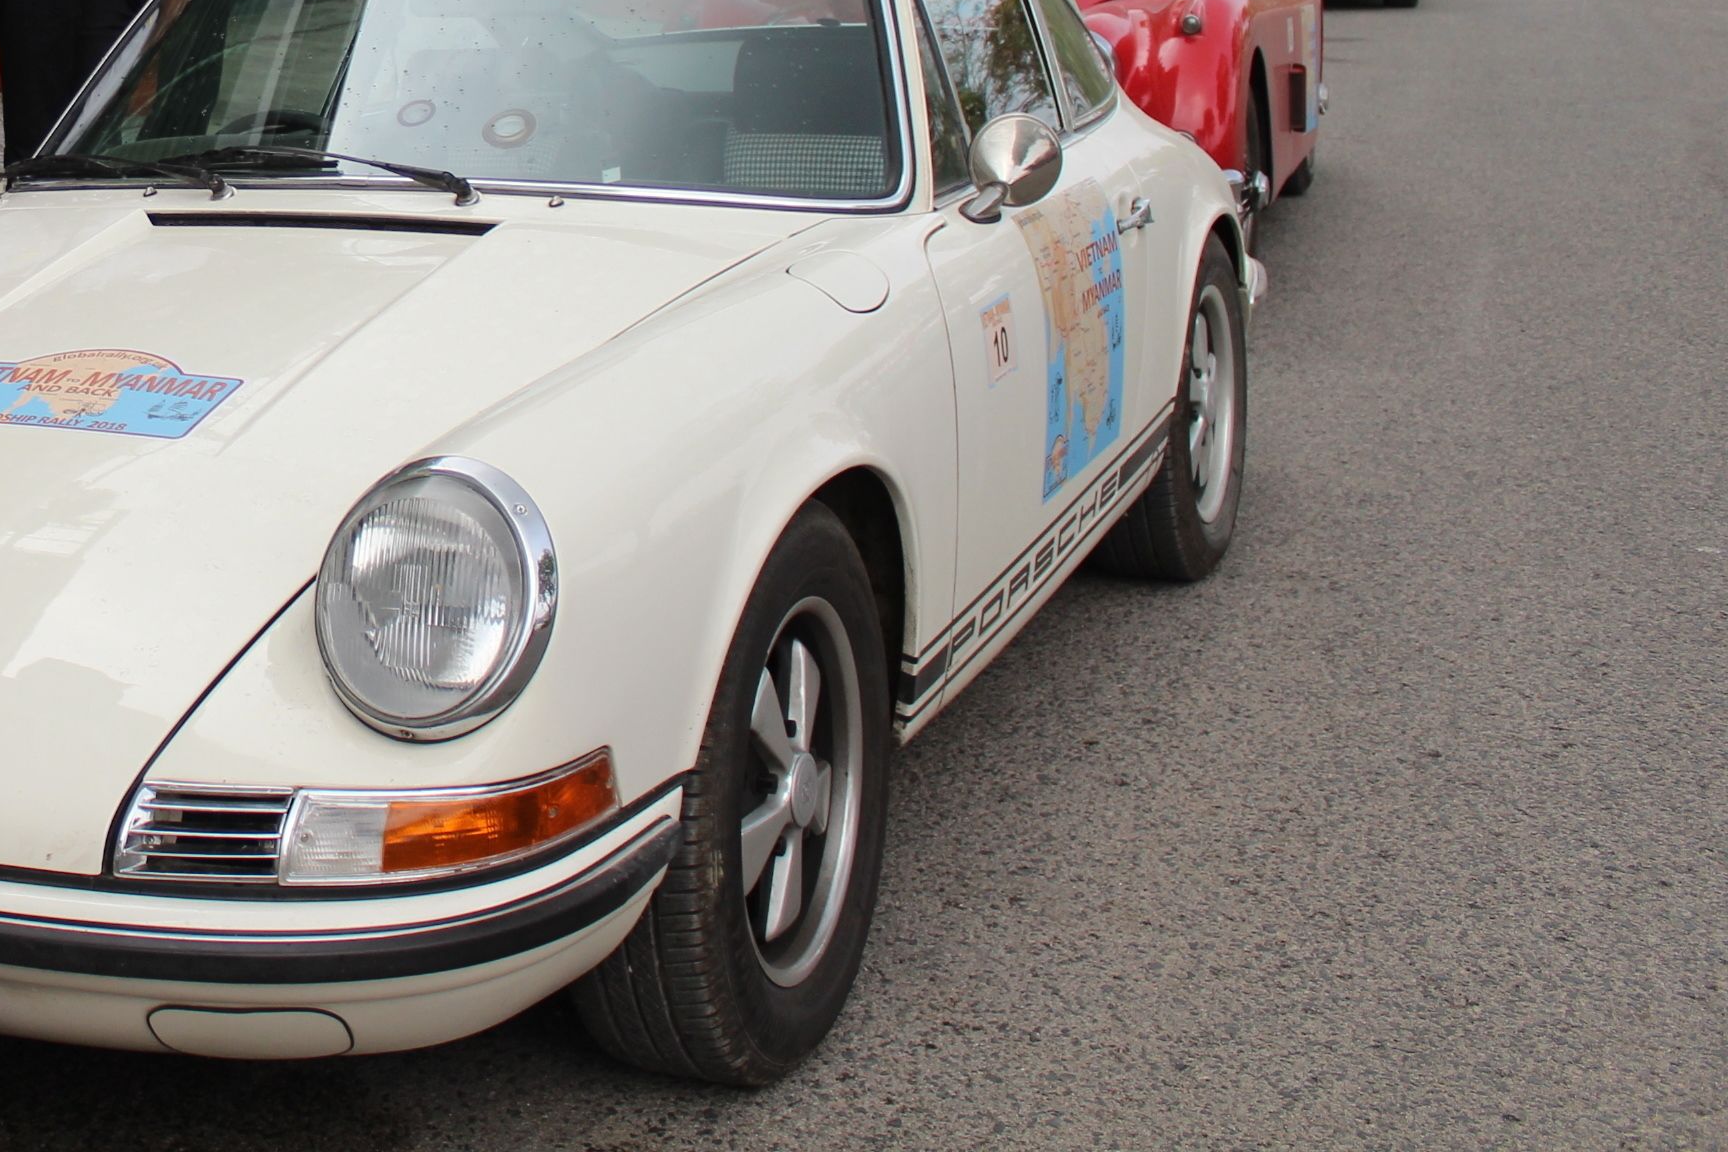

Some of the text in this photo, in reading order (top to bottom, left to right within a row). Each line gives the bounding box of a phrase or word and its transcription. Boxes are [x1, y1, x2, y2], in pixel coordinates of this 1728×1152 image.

[1075, 230, 1118, 273] VIETNAM
[1082, 268, 1122, 314] MYANMAR
[993, 326, 1009, 368] 10
[16, 383, 118, 398] AND BACK
[79, 371, 227, 402] MYANMAR
[36, 416, 85, 427] RALLY
[87, 420, 129, 431] 2018
[946, 468, 1120, 674] PORSCHE
